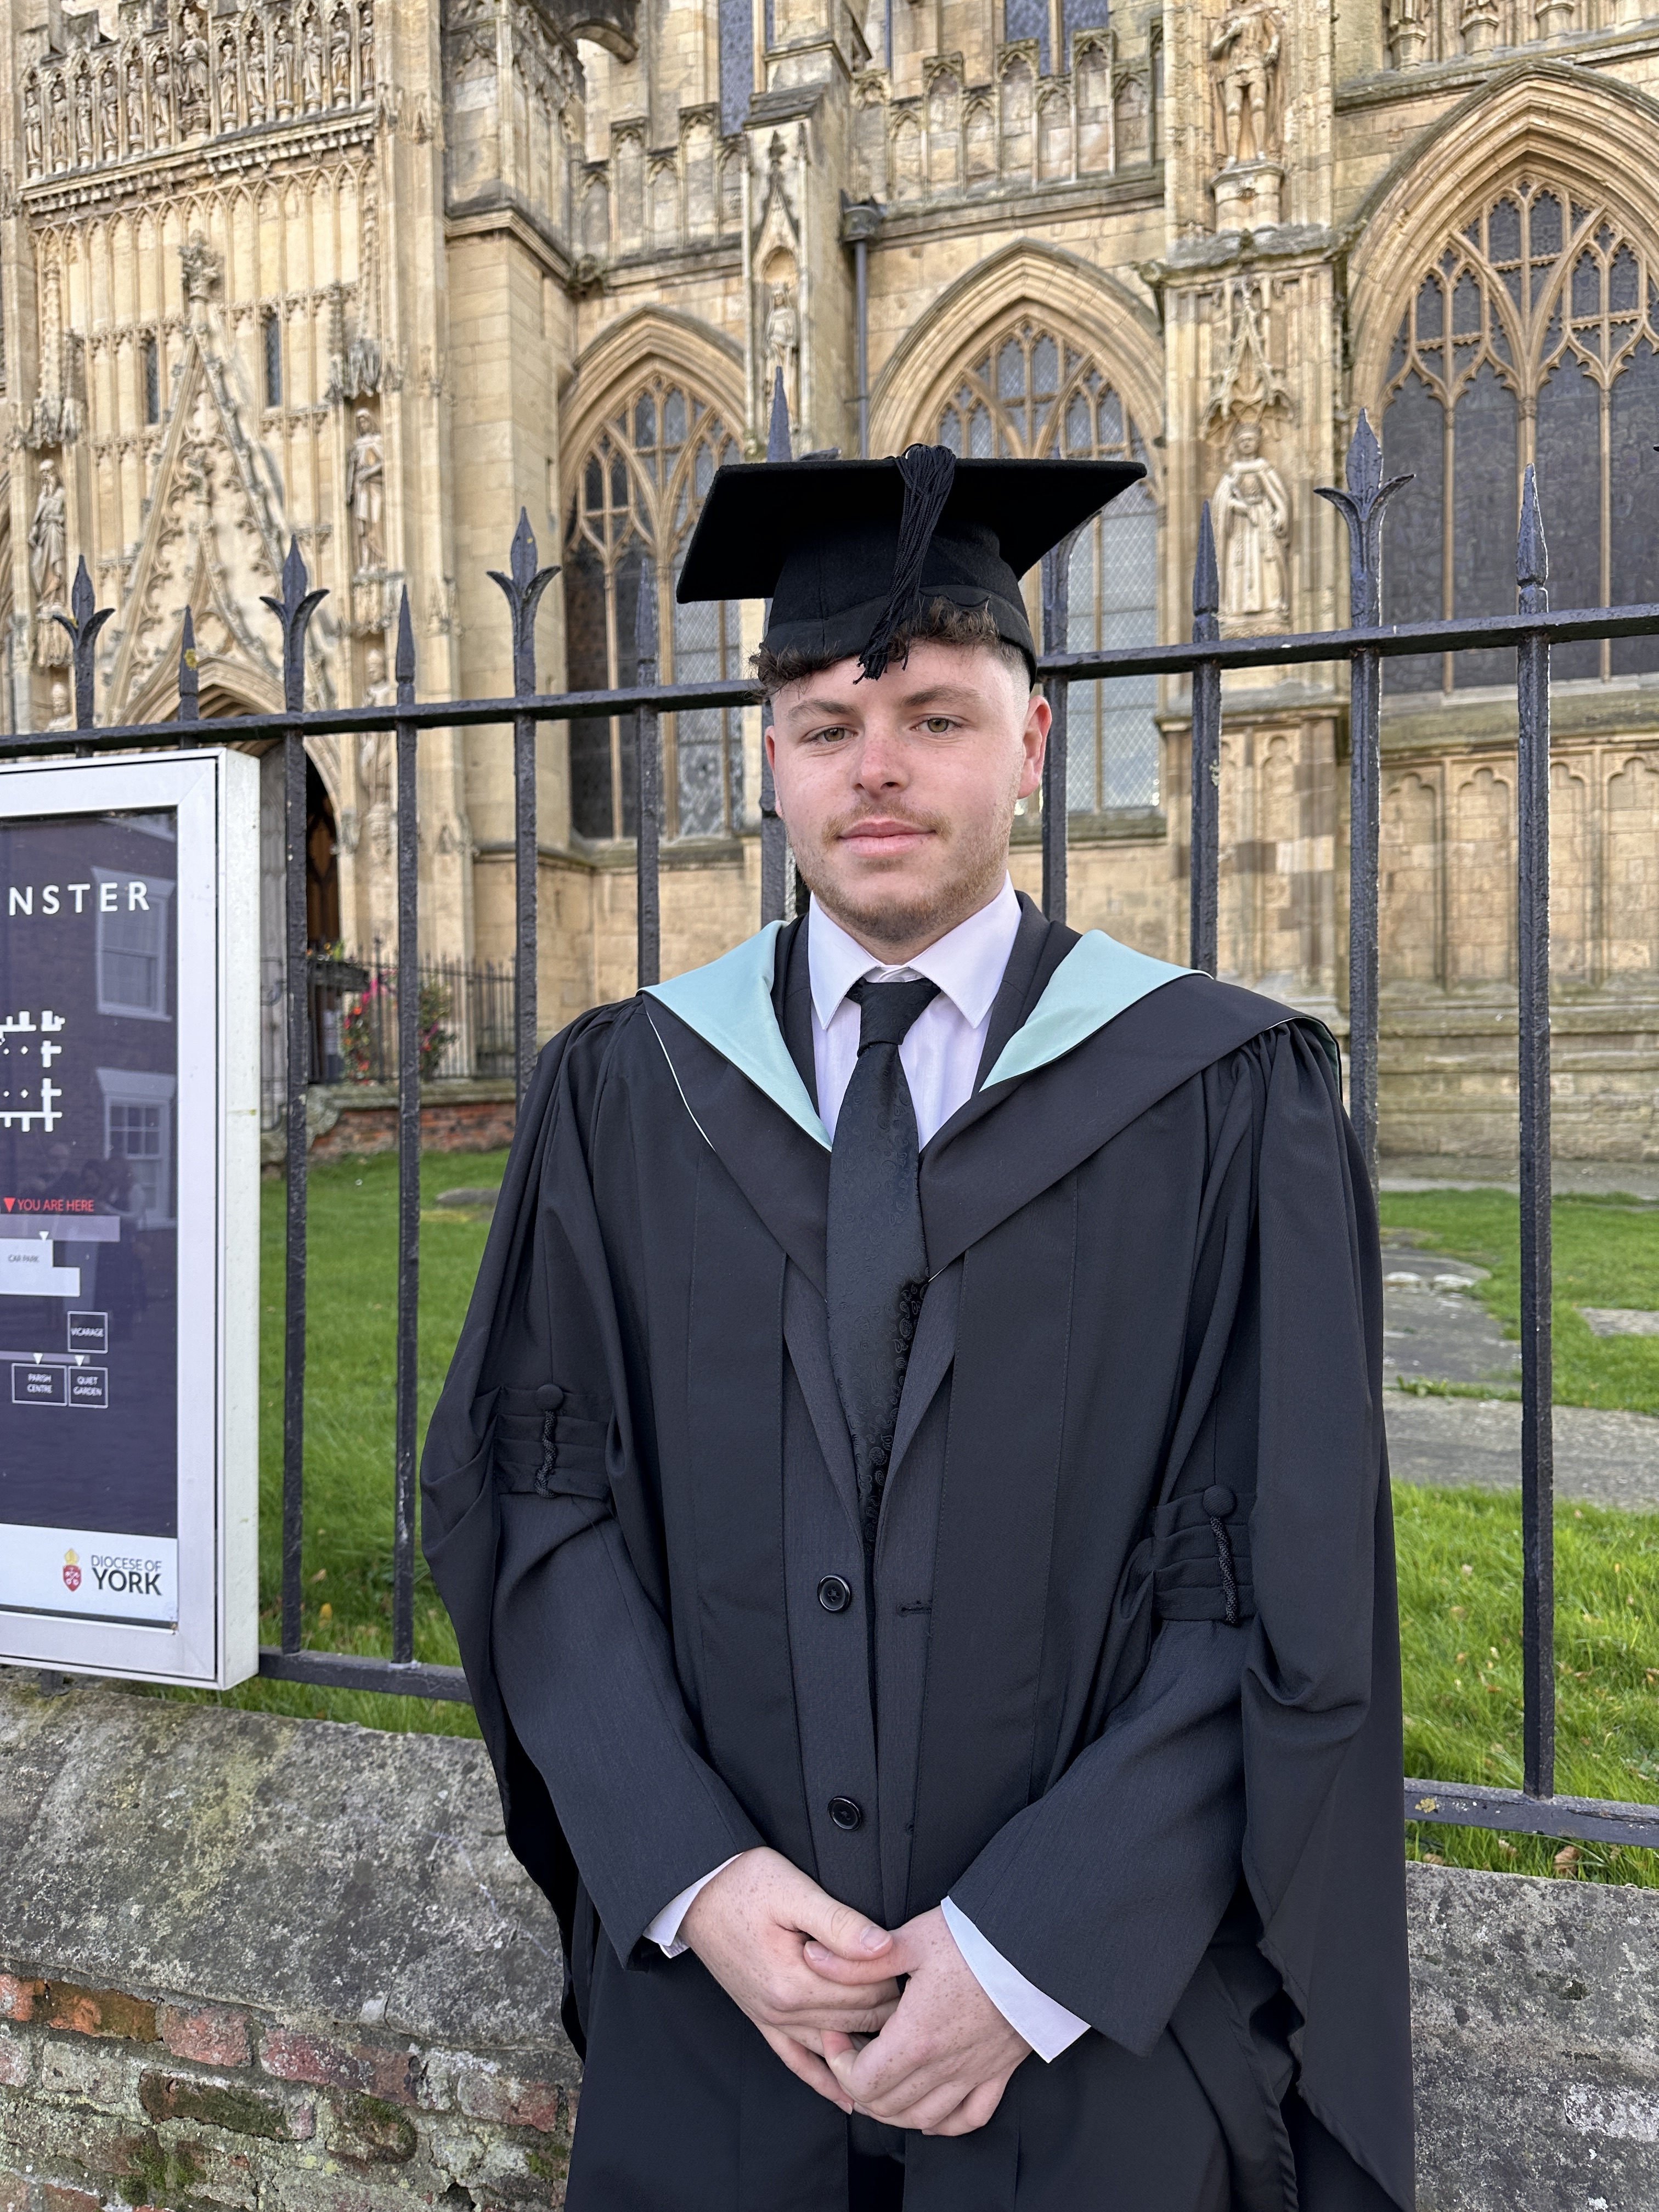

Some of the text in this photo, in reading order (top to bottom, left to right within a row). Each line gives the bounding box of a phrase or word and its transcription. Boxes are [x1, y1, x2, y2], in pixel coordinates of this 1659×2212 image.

[8, 881, 150, 916] NSTER
[18, 1199, 95, 1212] YOU ARE HERE
[91, 1555, 162, 1572] DIOCESE OF
[92, 1567, 162, 1596] YORK
